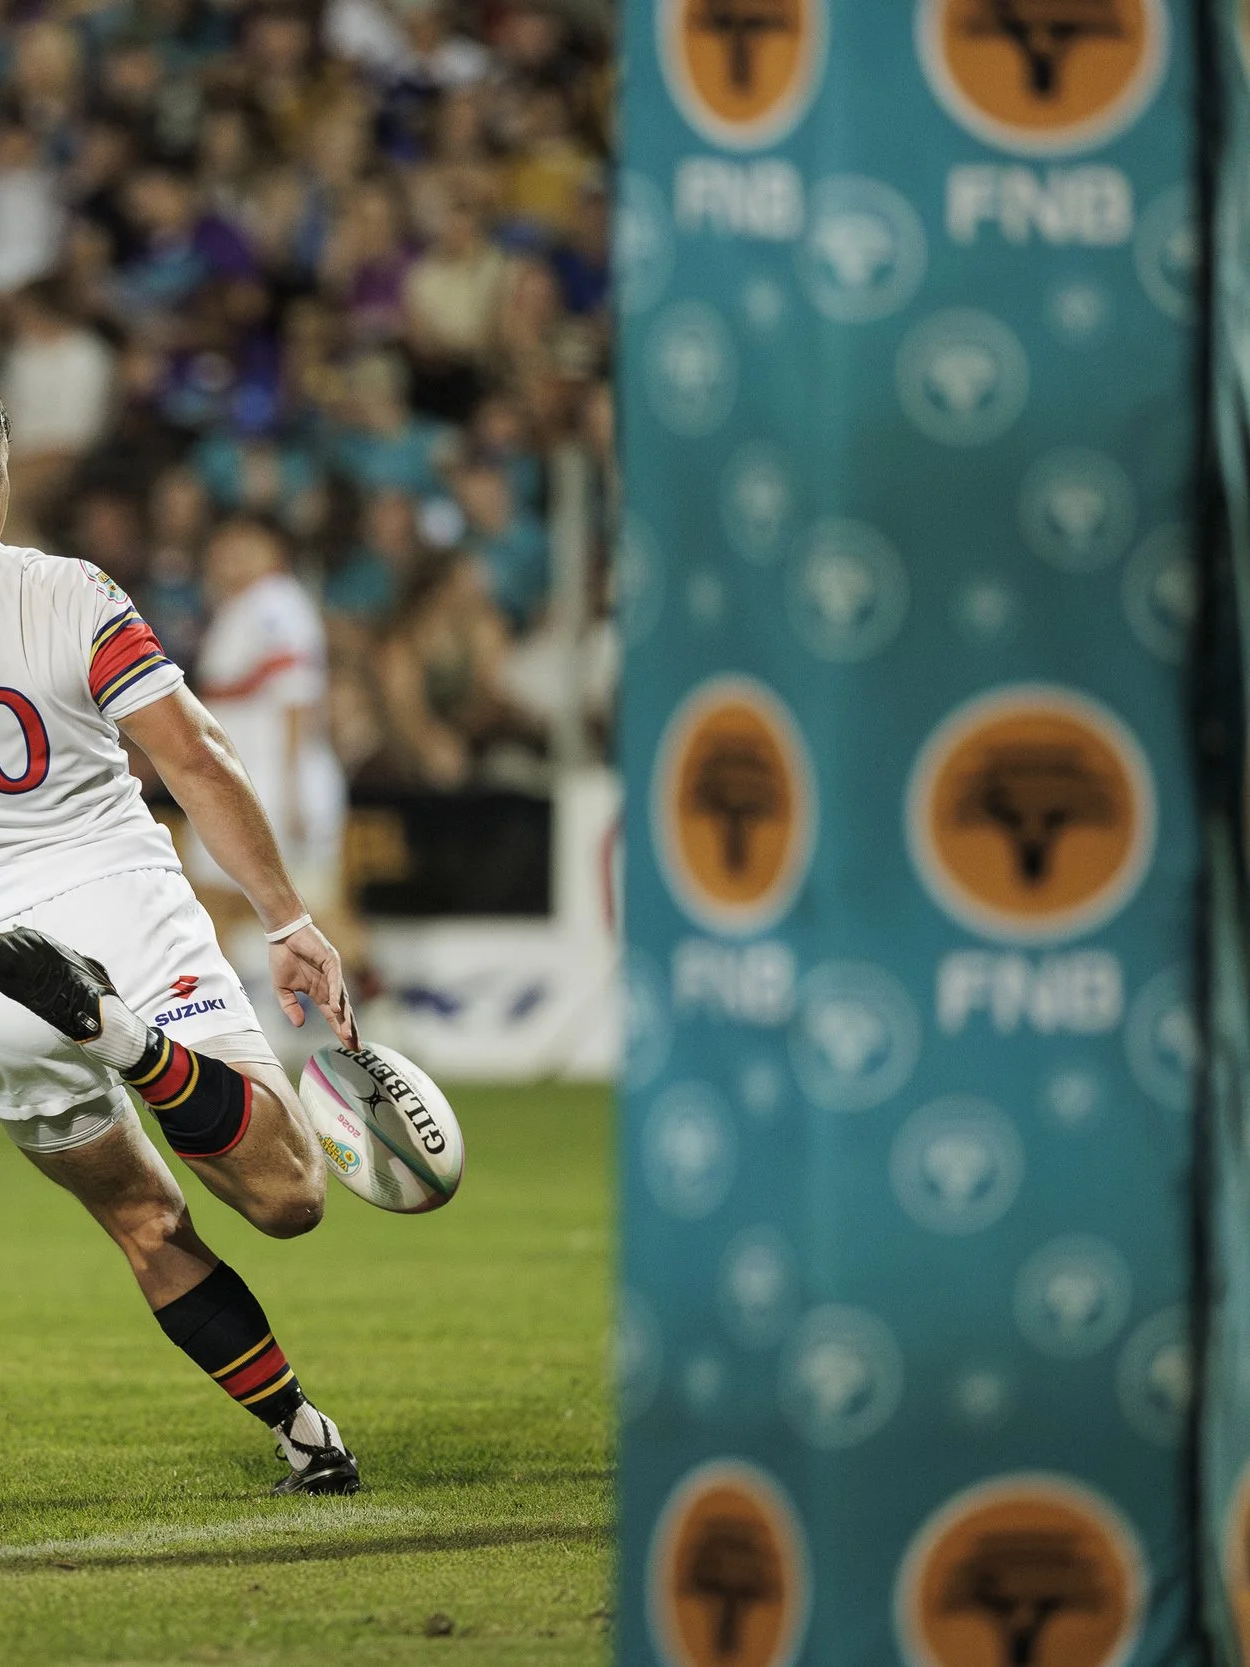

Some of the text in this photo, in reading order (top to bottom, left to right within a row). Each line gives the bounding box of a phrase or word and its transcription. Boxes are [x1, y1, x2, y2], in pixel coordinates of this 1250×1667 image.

[674, 156, 806, 241] FNB
[945, 163, 1134, 246] FNB
[154, 998, 227, 1027] SUZUKI
[935, 947, 1124, 1037] FNB
